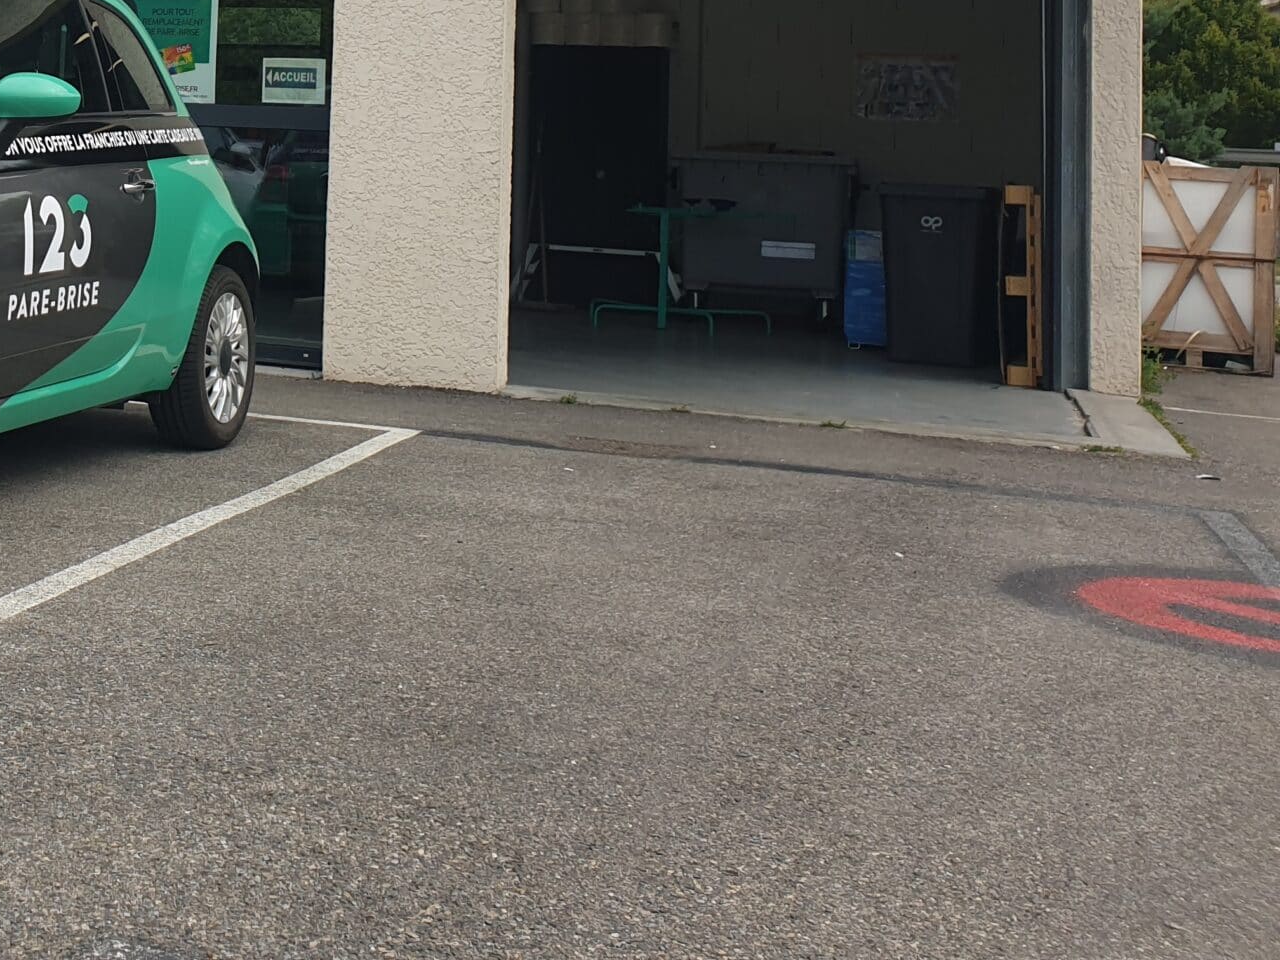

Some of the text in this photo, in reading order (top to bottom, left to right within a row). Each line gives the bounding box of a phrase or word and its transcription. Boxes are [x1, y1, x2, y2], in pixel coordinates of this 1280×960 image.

[272, 71, 316, 83] ACCUEIL
[16, 136, 46, 154] VOUS
[44, 134, 74, 153] OFFRE
[72, 133, 86, 150] LA
[83, 131, 126, 150] FRANCHISE
[124, 130, 137, 145] OU
[23, 194, 92, 276] 123
[7, 281, 100, 321] PARE-BRISE
